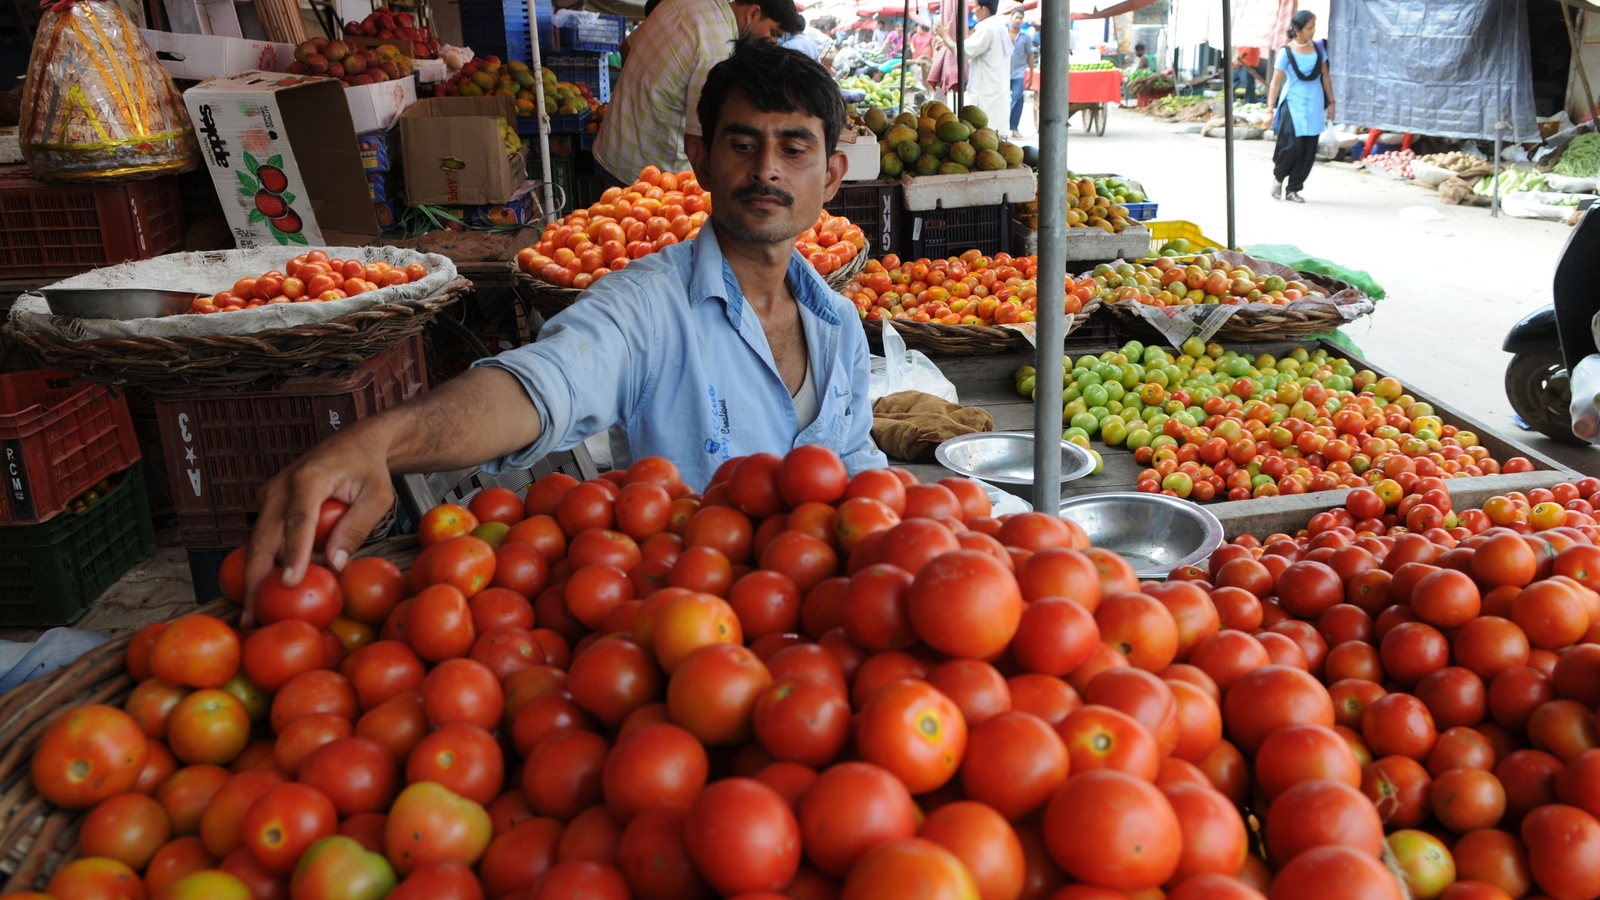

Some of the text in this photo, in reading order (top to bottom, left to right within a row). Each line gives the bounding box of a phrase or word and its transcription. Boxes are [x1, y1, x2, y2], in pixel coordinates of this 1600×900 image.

[261, 106, 269, 128] EXPORT
[264, 105, 274, 128] QUALITY
[204, 137, 216, 166] HIMACHAL
[882, 195, 891, 252] GKK
[718, 398, 730, 435] Creations
